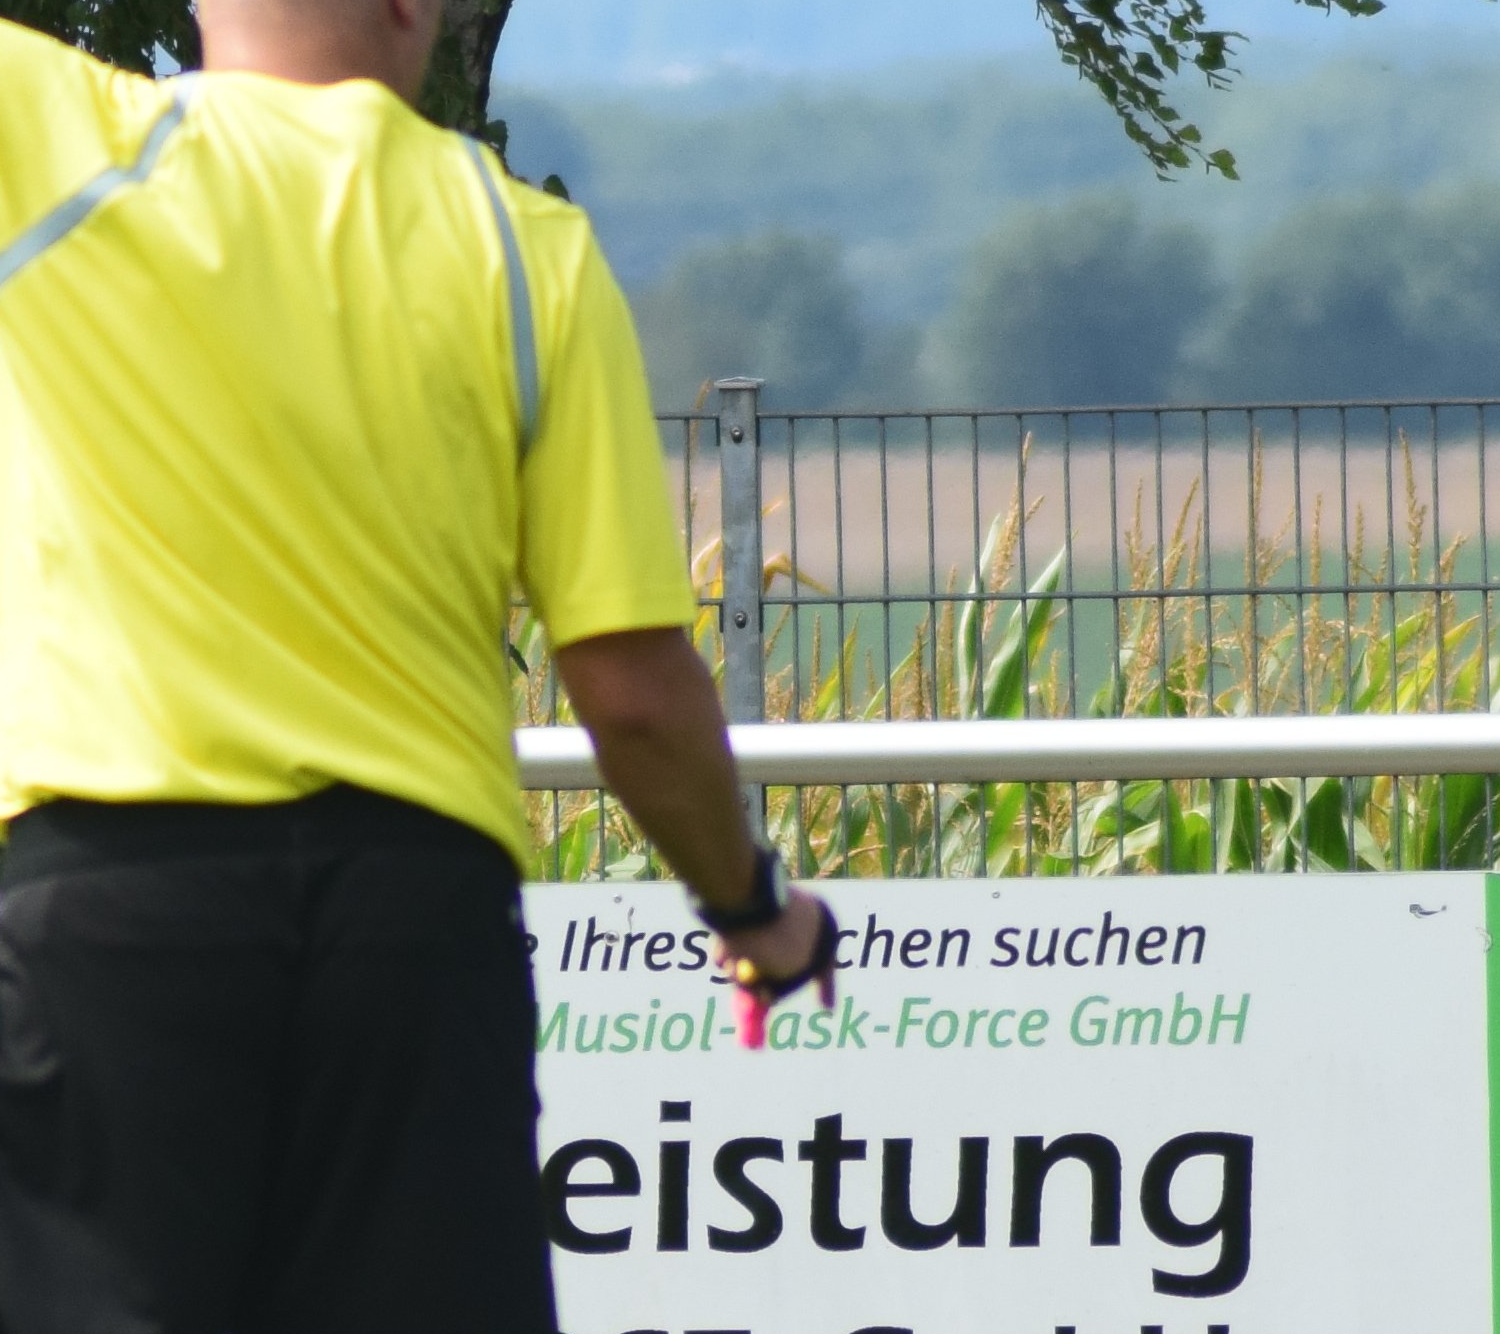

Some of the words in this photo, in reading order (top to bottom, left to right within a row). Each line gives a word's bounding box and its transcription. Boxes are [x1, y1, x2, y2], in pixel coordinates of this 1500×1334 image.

[990, 910, 1208, 967] suchen
[536, 991, 1050, 1054] Musiol-ask-Force
[1069, 990, 1252, 1047] GmbH
